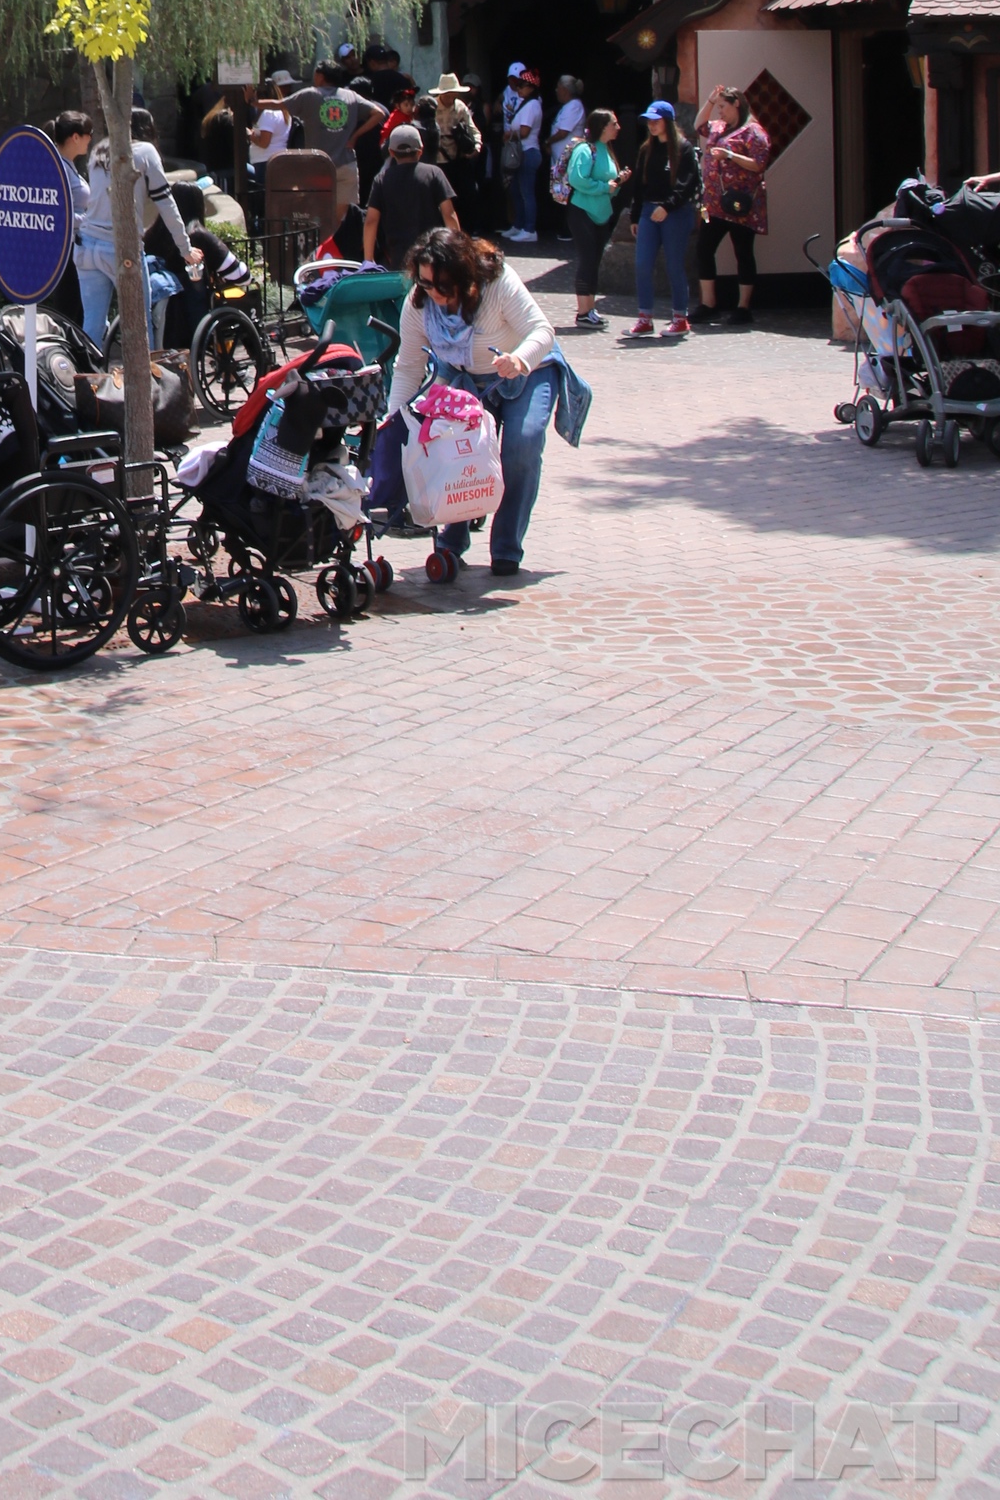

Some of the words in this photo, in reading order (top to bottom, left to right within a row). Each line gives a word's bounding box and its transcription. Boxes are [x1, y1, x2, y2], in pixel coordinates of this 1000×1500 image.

[328, 106, 341, 121] H
[250, 308, 257, 319] 2
[461, 464, 477, 477] Life
[444, 482, 451, 491] is
[452, 474, 495, 490] ridiculously
[446, 486, 495, 505] AWESOME
